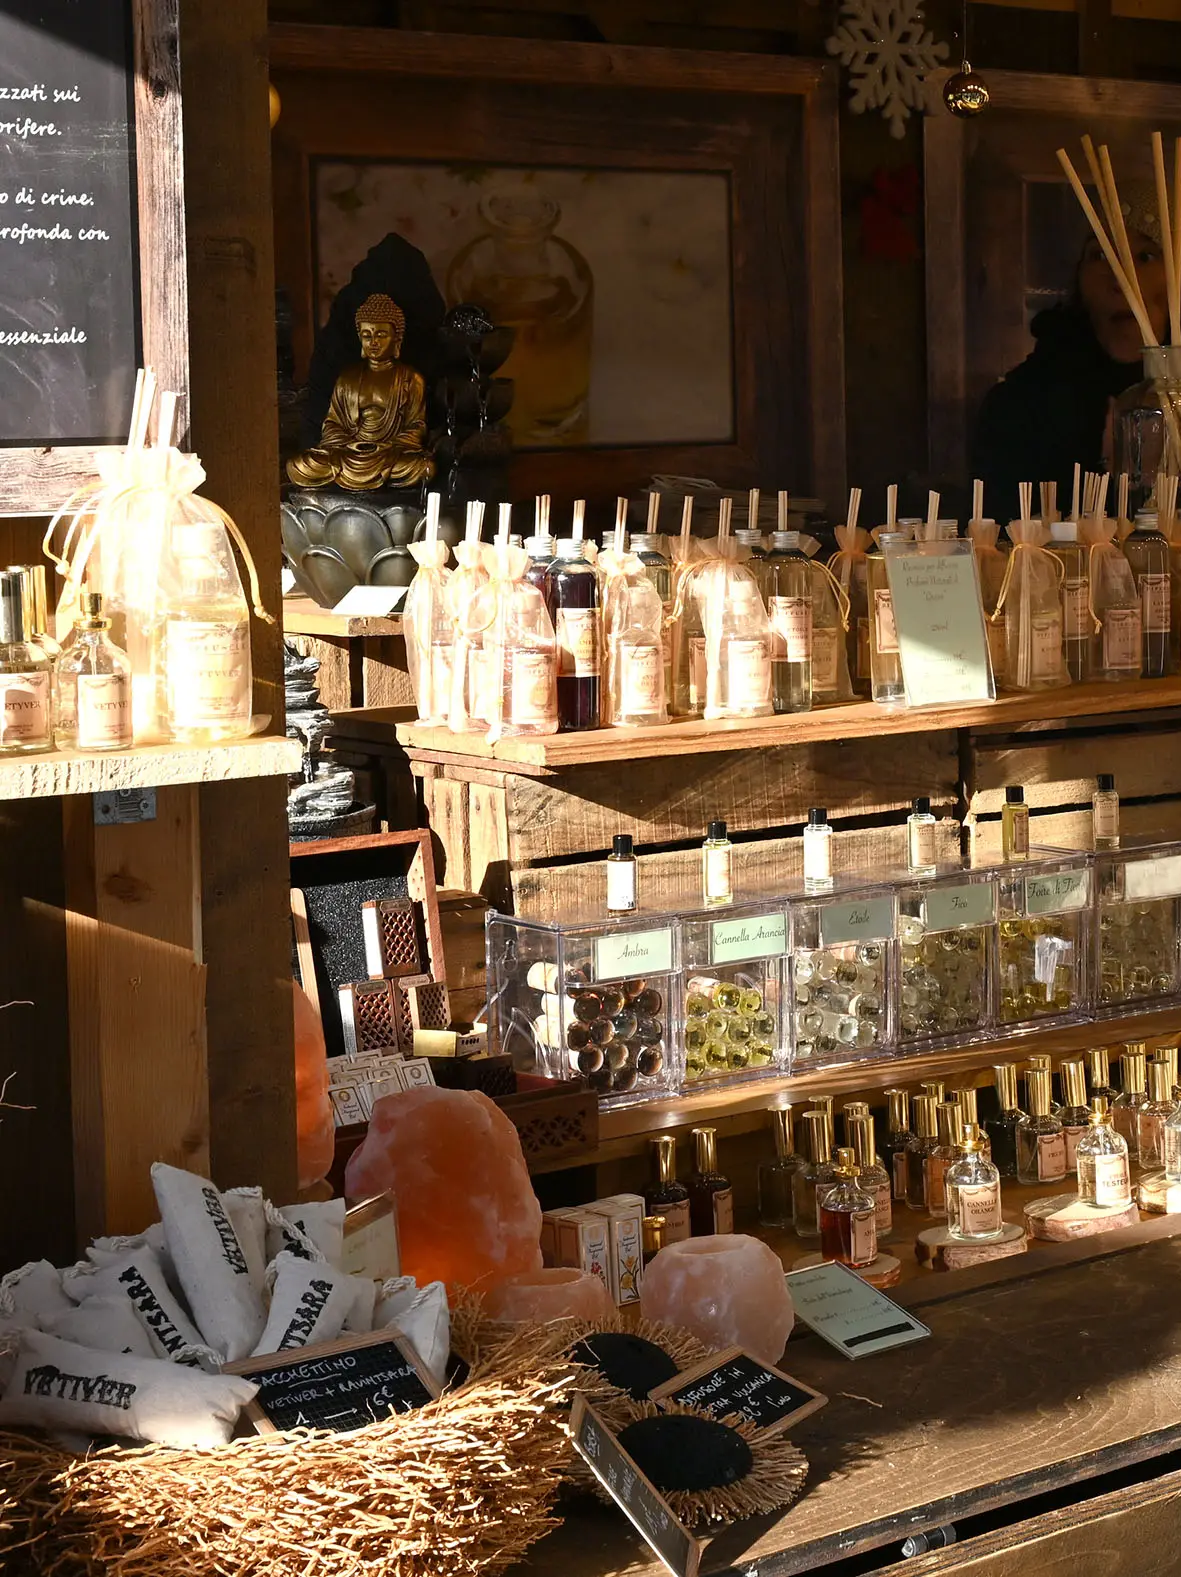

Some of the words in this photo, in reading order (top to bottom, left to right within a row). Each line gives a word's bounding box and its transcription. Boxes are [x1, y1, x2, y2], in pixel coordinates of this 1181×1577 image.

[0, 84, 47, 102] zzati
[53, 85, 81, 103] sui
[15, 187, 36, 205] di
[41, 188, 94, 206] crine.
[78, 228, 110, 240] con
[4, 700, 41, 711] ETYVER
[93, 700, 129, 710] VETYVE
[714, 928, 750, 946] Cannella
[752, 926, 787, 942] Arancia
[617, 943, 649, 960] Ambra
[202, 1187, 249, 1275] VETIVER
[23, 1364, 137, 1410] VETIVER
